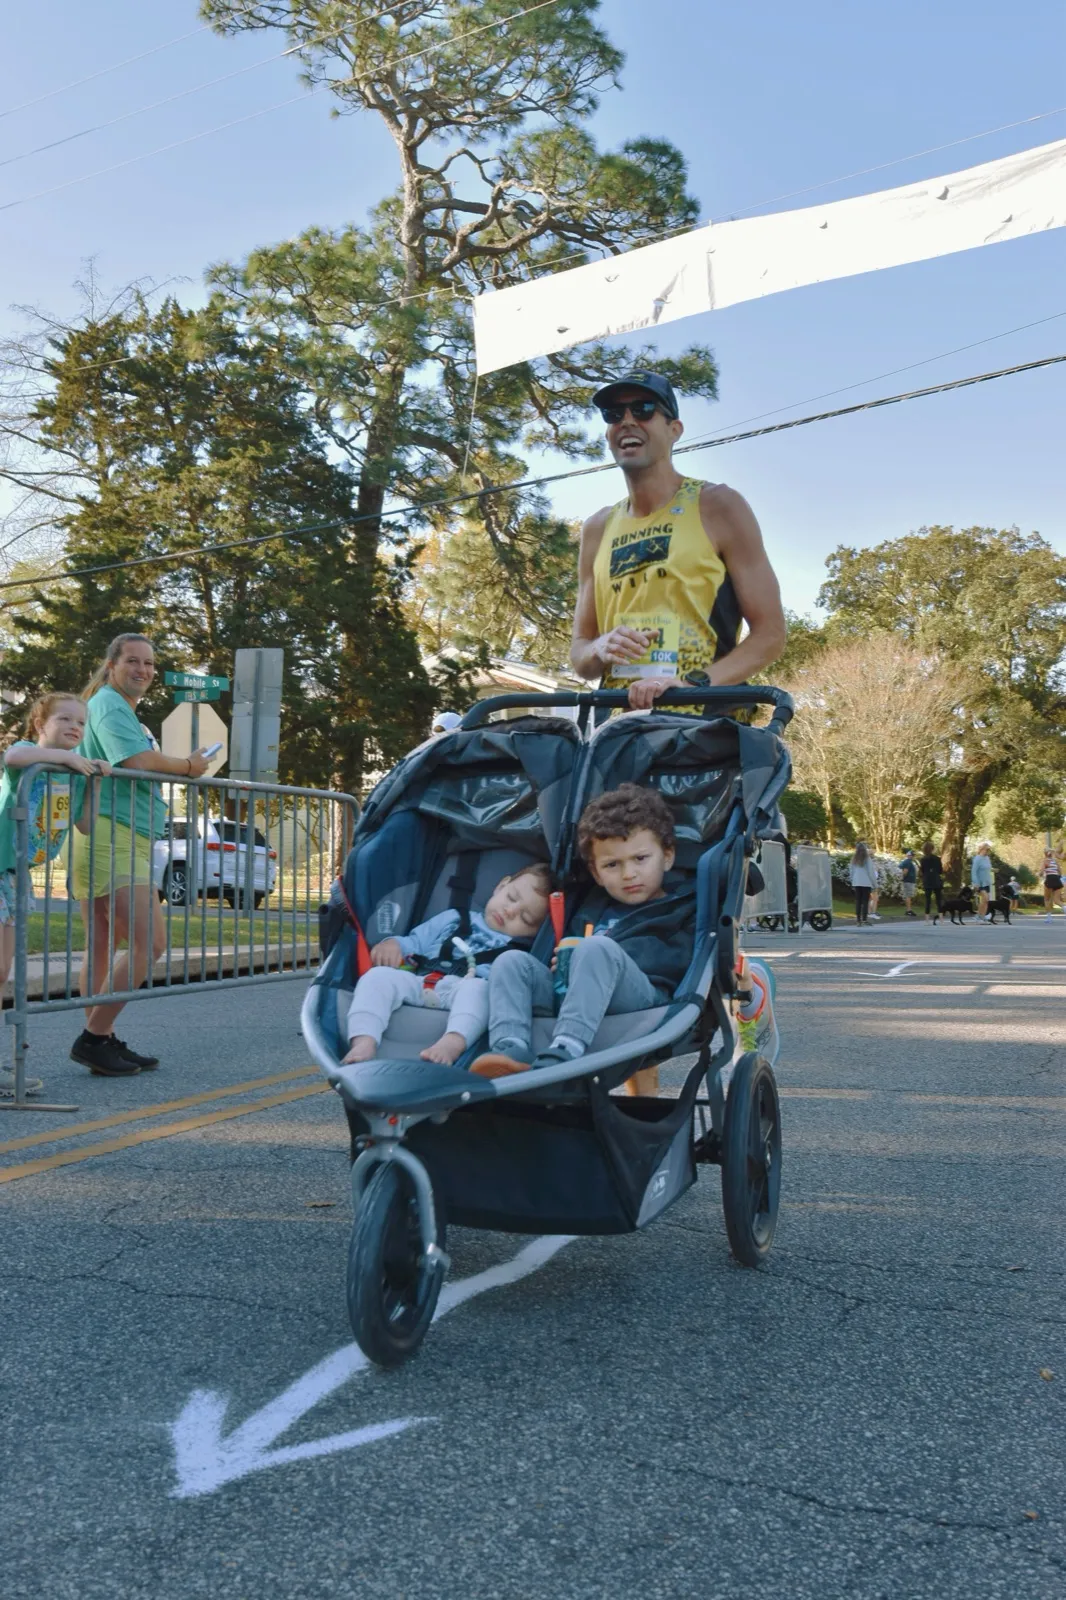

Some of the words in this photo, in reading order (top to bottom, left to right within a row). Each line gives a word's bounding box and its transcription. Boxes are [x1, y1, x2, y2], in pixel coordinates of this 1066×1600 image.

[612, 523, 673, 548] RUNNING
[652, 651, 673, 662] 10K
[172, 674, 178, 685] S
[183, 676, 206, 688] Mobile
